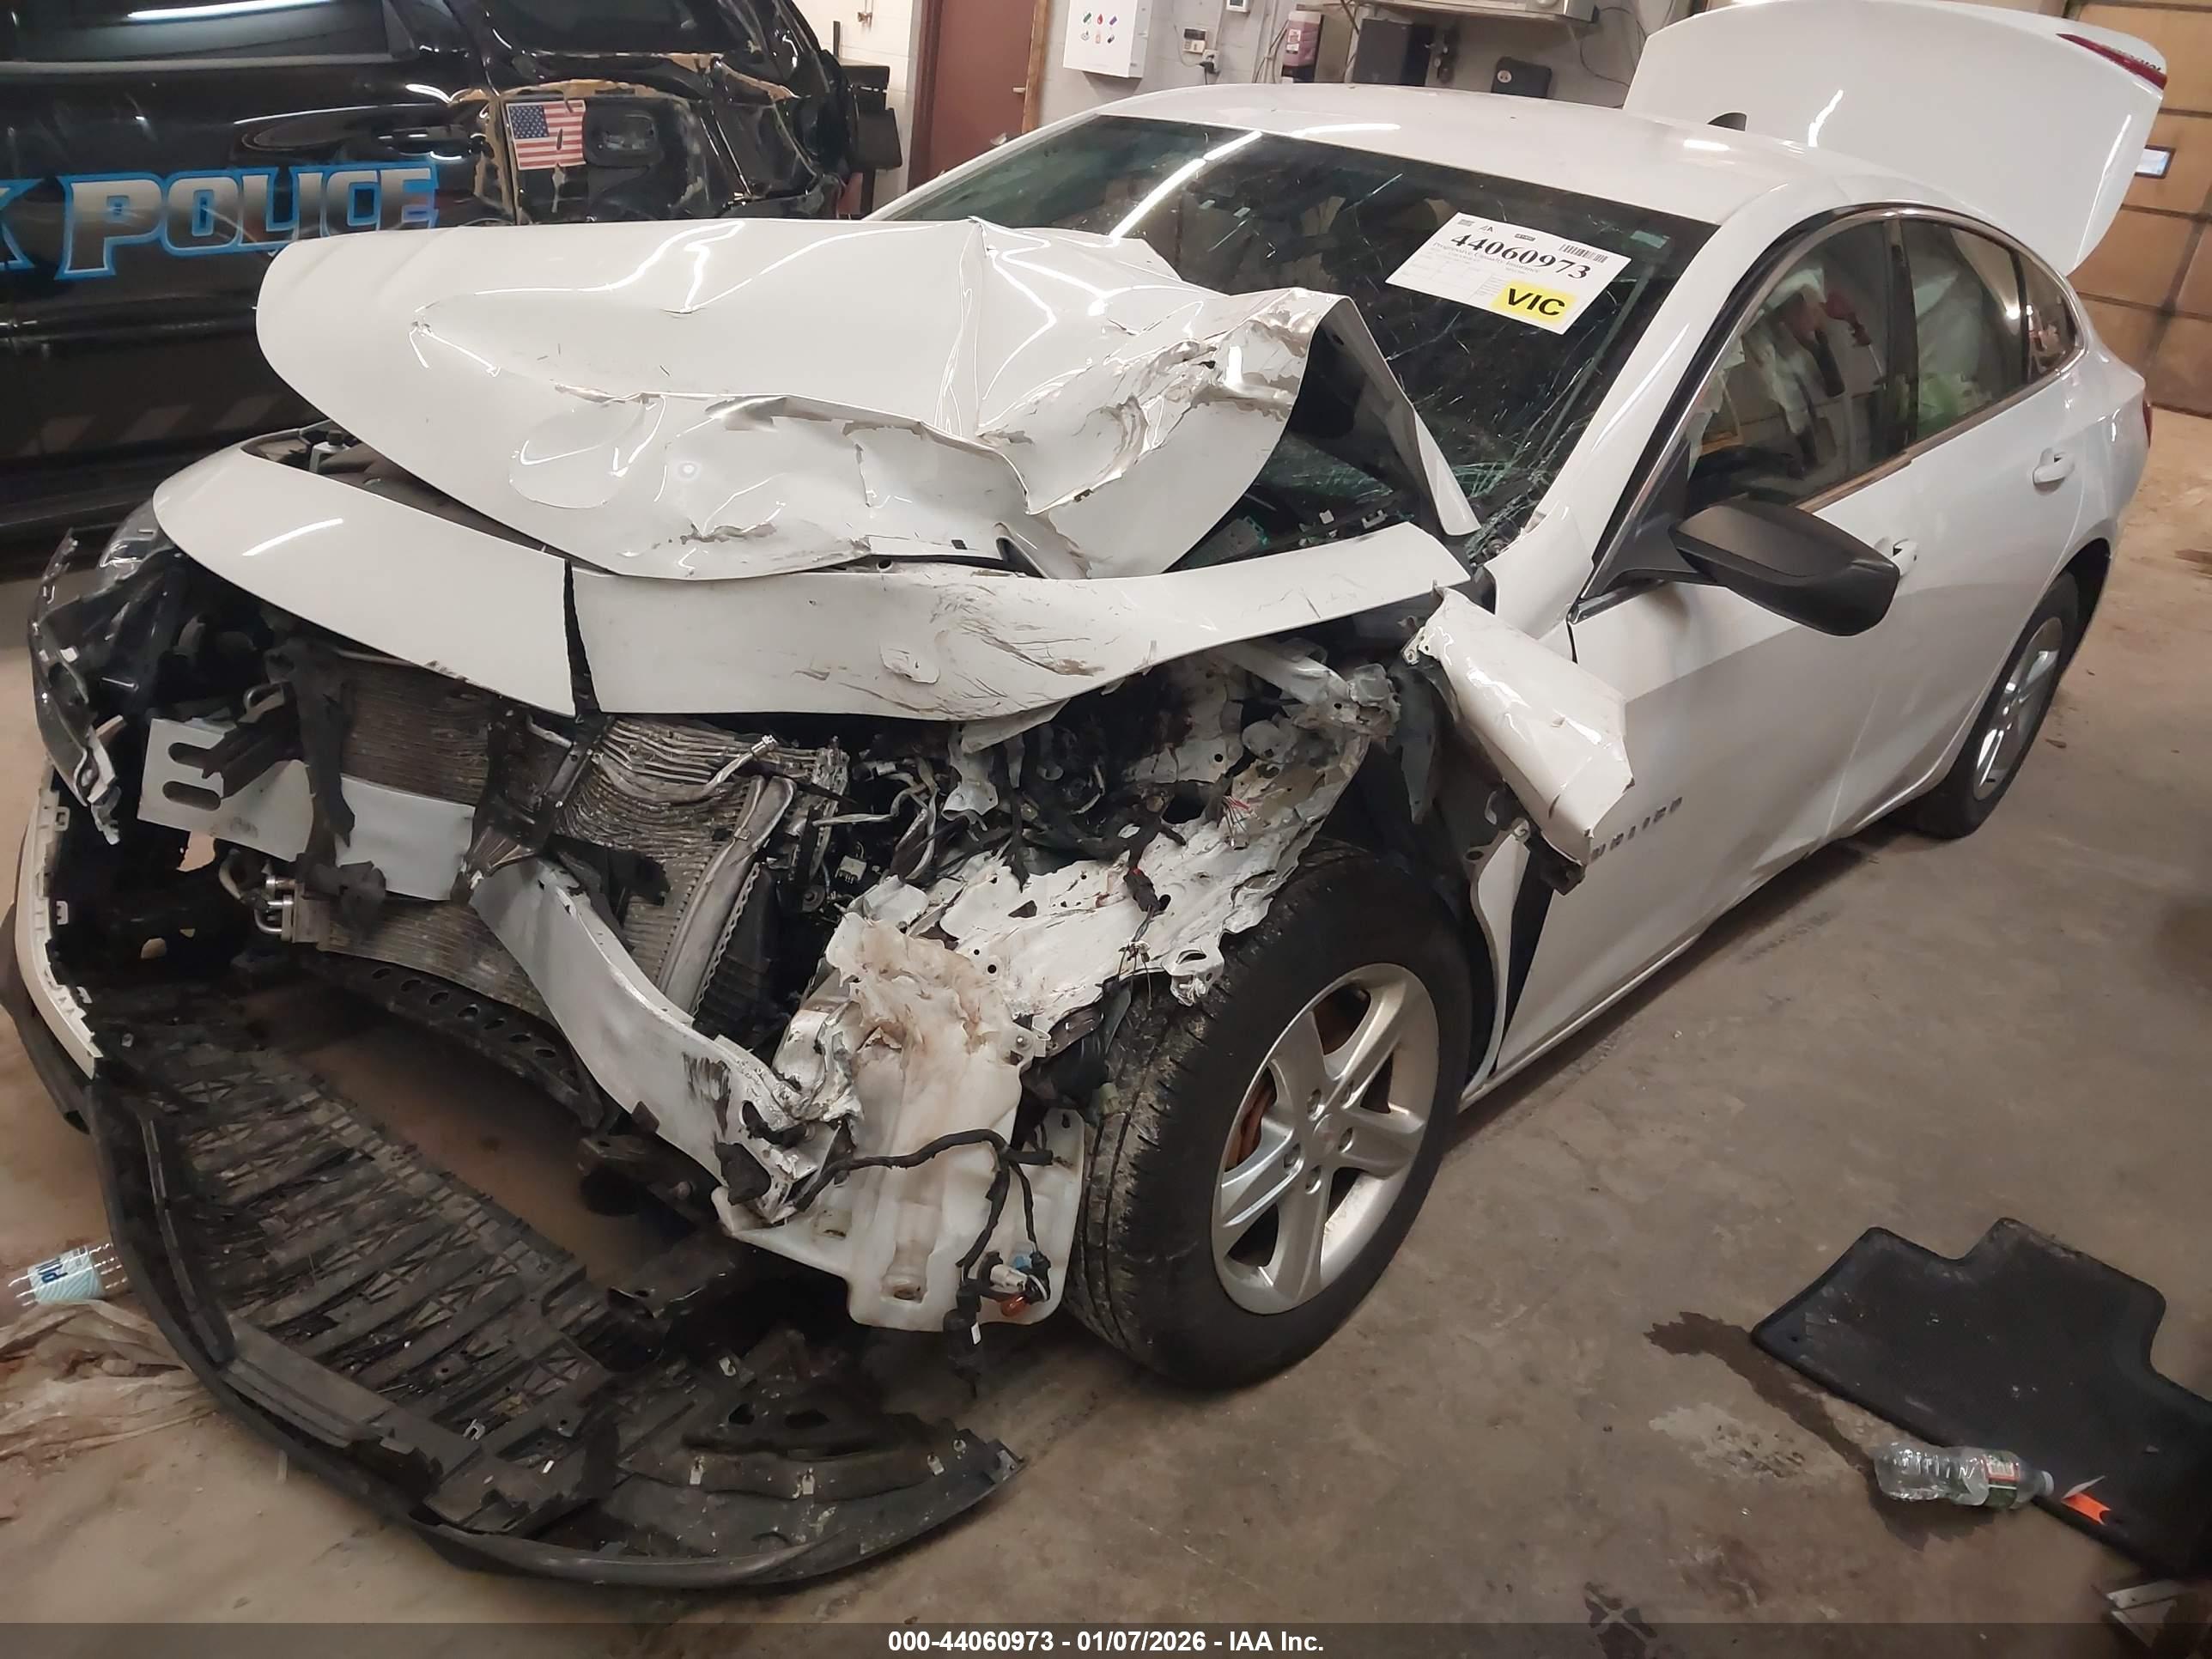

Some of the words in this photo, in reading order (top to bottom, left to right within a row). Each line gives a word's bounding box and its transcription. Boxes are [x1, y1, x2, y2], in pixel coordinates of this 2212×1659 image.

[55, 161, 439, 280] POLICE
[1451, 234, 1590, 279] 44060973
[1508, 288, 1565, 316] VIC
